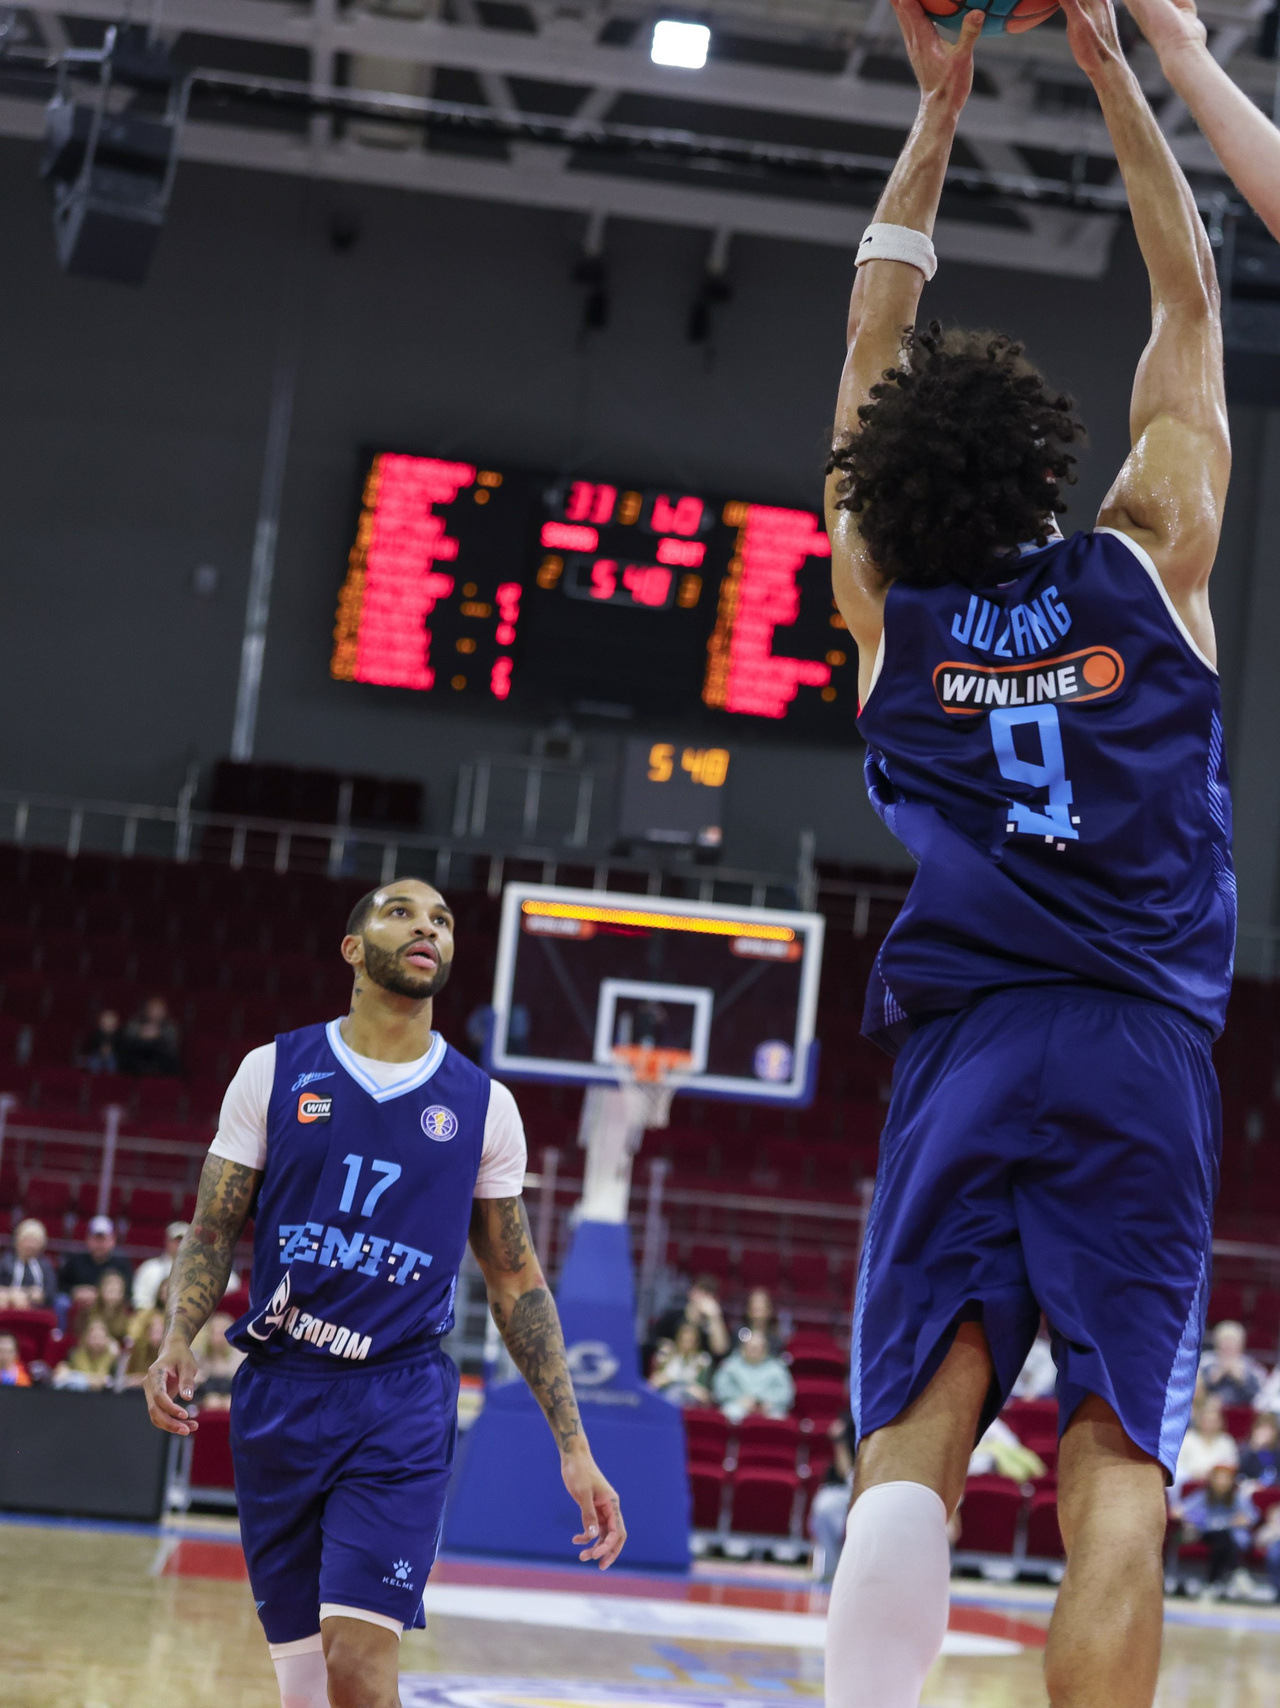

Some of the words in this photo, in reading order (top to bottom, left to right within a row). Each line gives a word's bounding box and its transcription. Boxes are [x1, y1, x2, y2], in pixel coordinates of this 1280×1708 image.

[951, 585, 1072, 658] JUZANG
[943, 665, 1078, 705] WINLINE
[306, 1103, 331, 1113] WIN
[338, 1153, 402, 1218] 17
[278, 1221, 433, 1286] ZENIT
[382, 1576, 414, 1591] KELME
